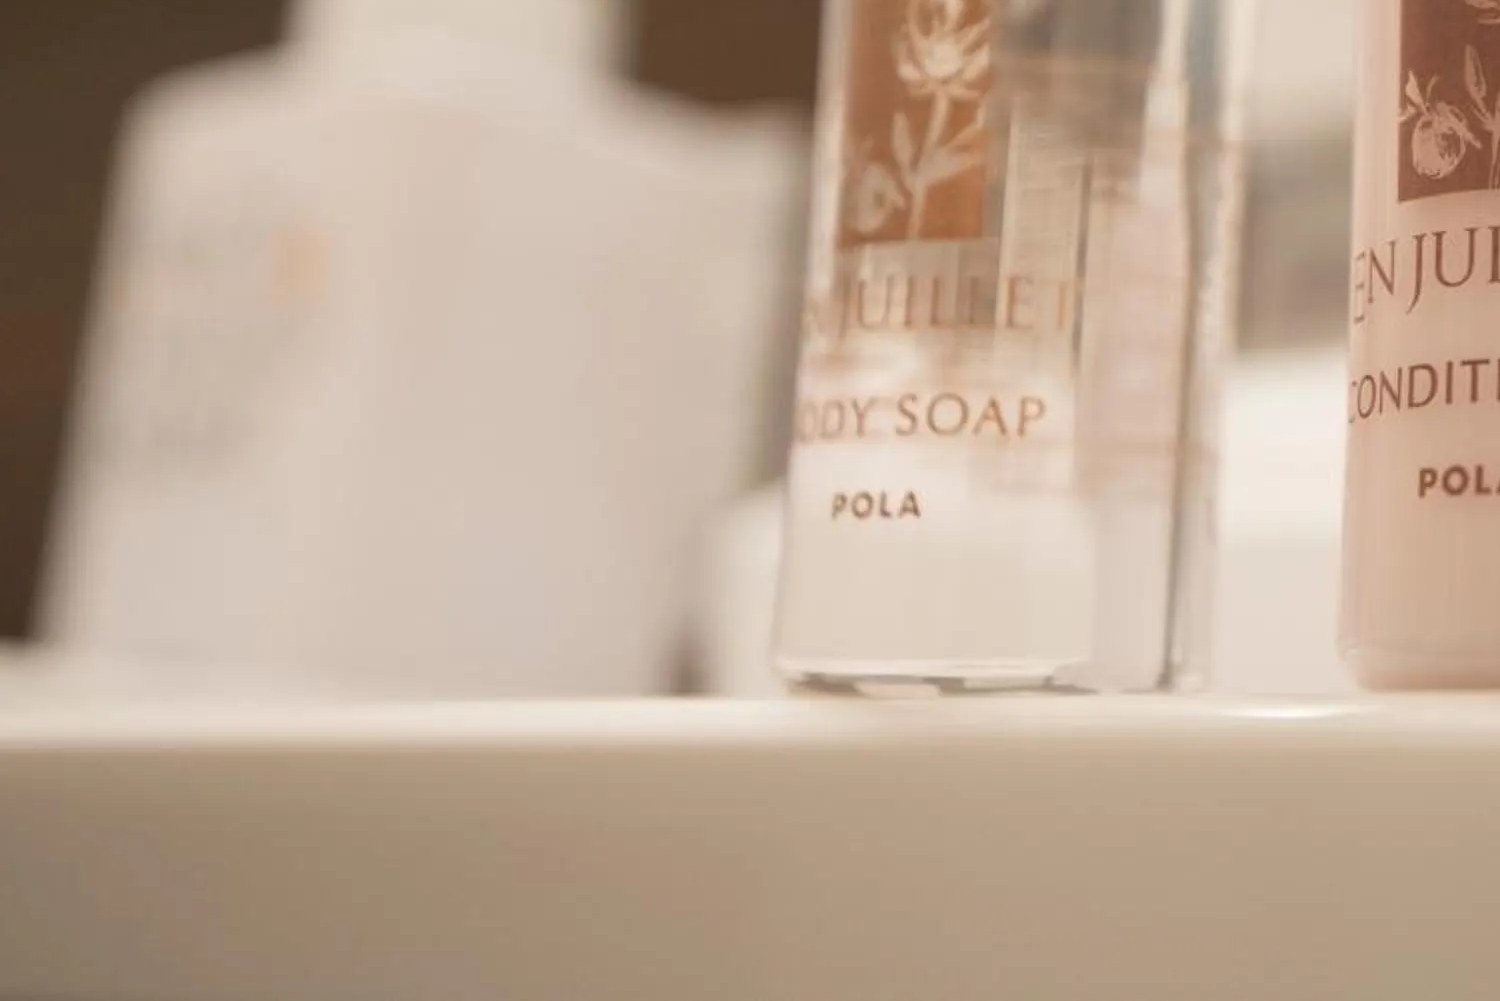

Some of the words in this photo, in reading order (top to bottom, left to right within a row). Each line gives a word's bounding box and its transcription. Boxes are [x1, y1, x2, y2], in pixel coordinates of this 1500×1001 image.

[796, 397, 878, 444] ODY
[895, 393, 1047, 437] SOAP
[830, 490, 922, 519] POLA
